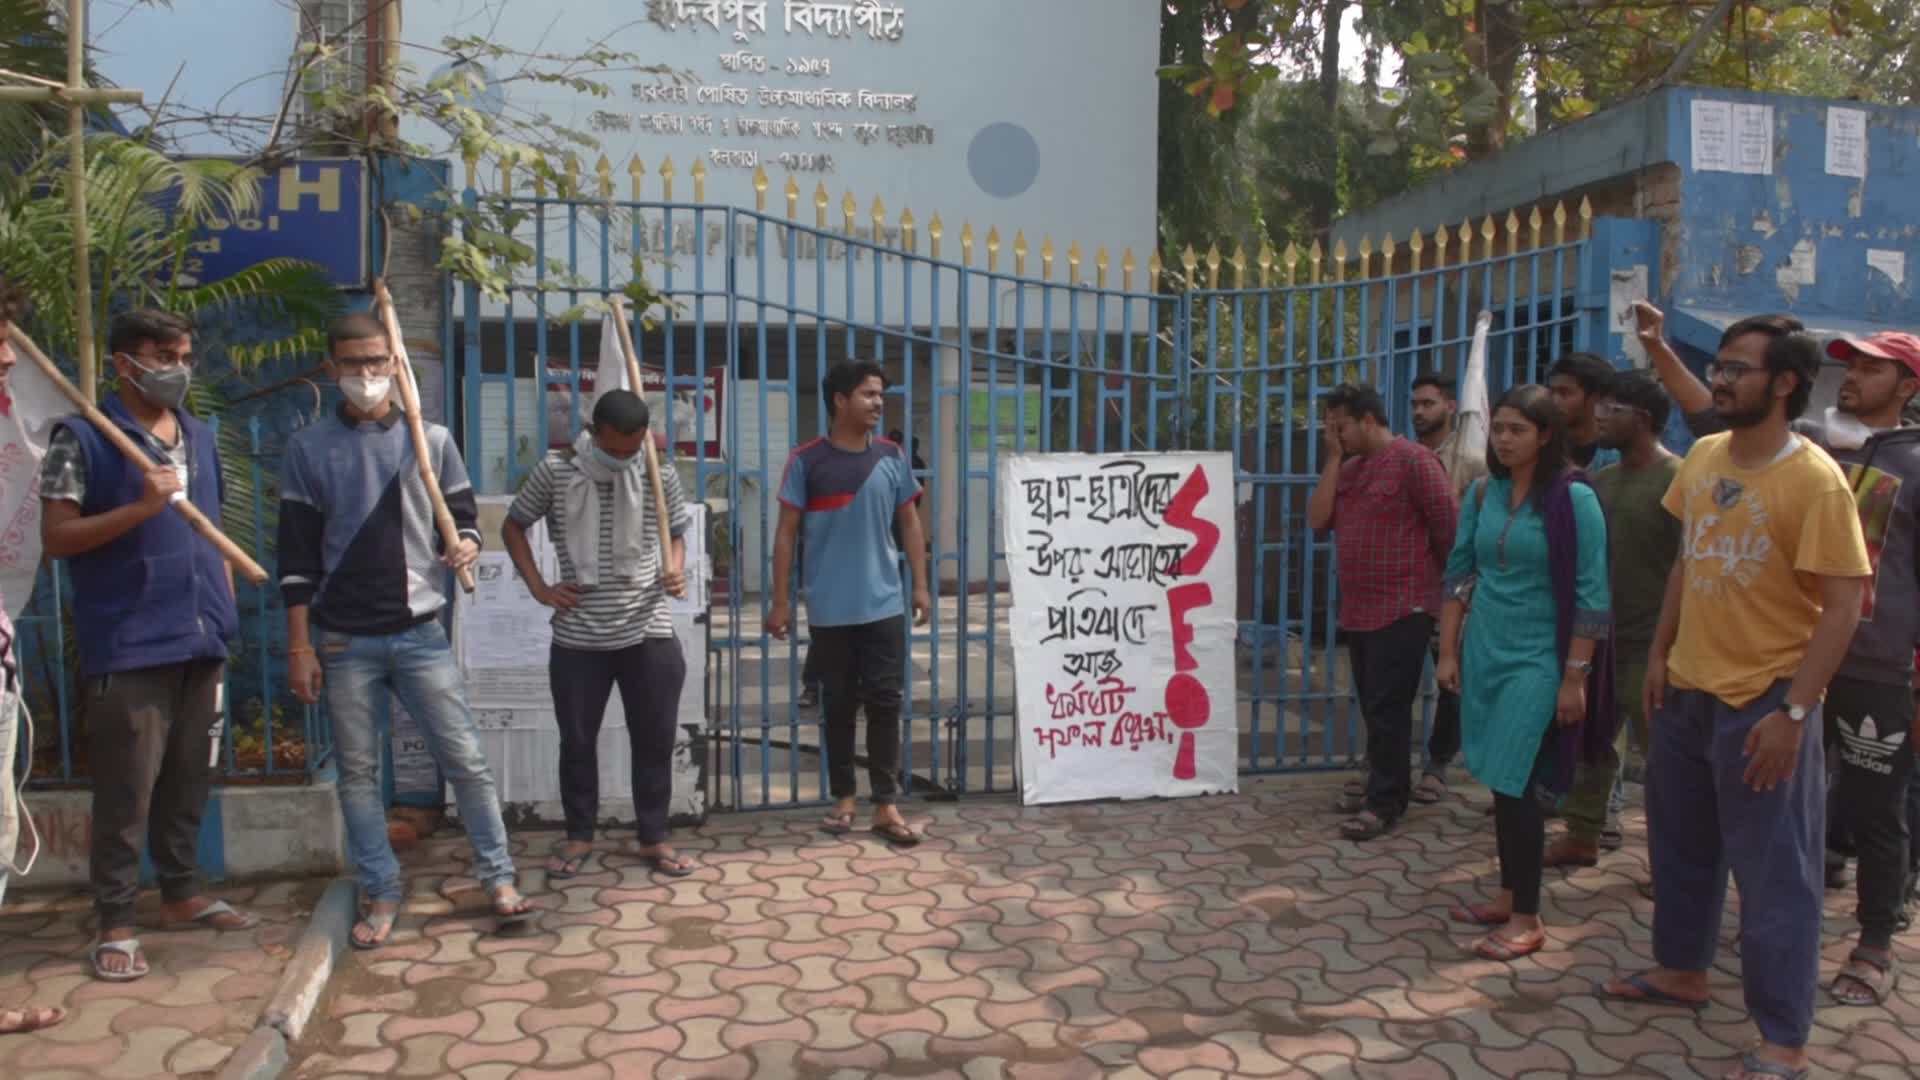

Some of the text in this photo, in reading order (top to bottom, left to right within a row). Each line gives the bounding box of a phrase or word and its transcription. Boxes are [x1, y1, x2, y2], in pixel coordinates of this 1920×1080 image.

[784, 55, 832, 75] ১৯৫৭
[697, 83, 749, 106] পোষিত
[1062, 648, 1123, 678] আজ
